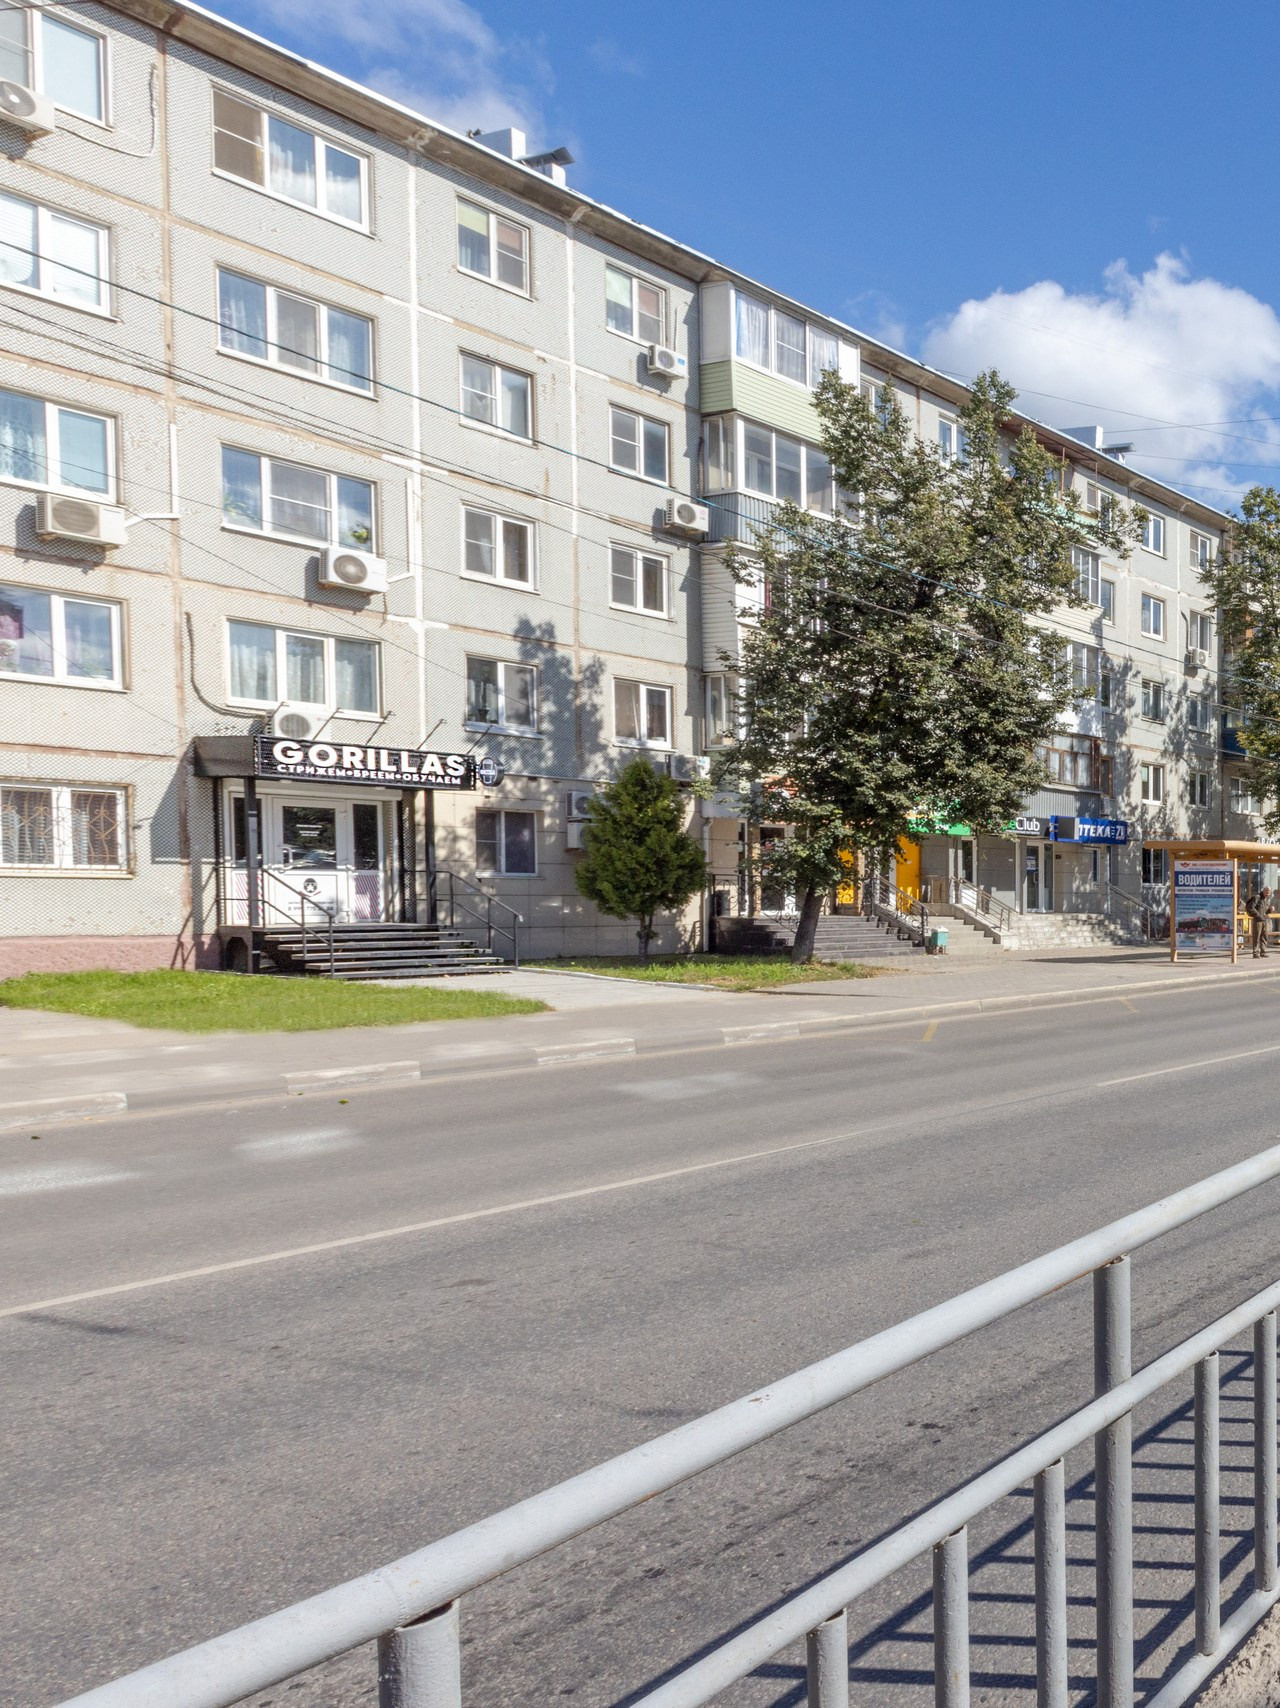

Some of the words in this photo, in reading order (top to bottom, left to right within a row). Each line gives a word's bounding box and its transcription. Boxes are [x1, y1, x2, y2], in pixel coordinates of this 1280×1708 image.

[273, 740, 465, 777] GORILLAS
[276, 764, 347, 777] СТРИЖЕМ
[353, 769, 396, 780] БРЕЕМ
[402, 773, 461, 785] ОБУЧАЕМ
[1178, 873, 1231, 886] ВОДИТЕЛЕЙ
